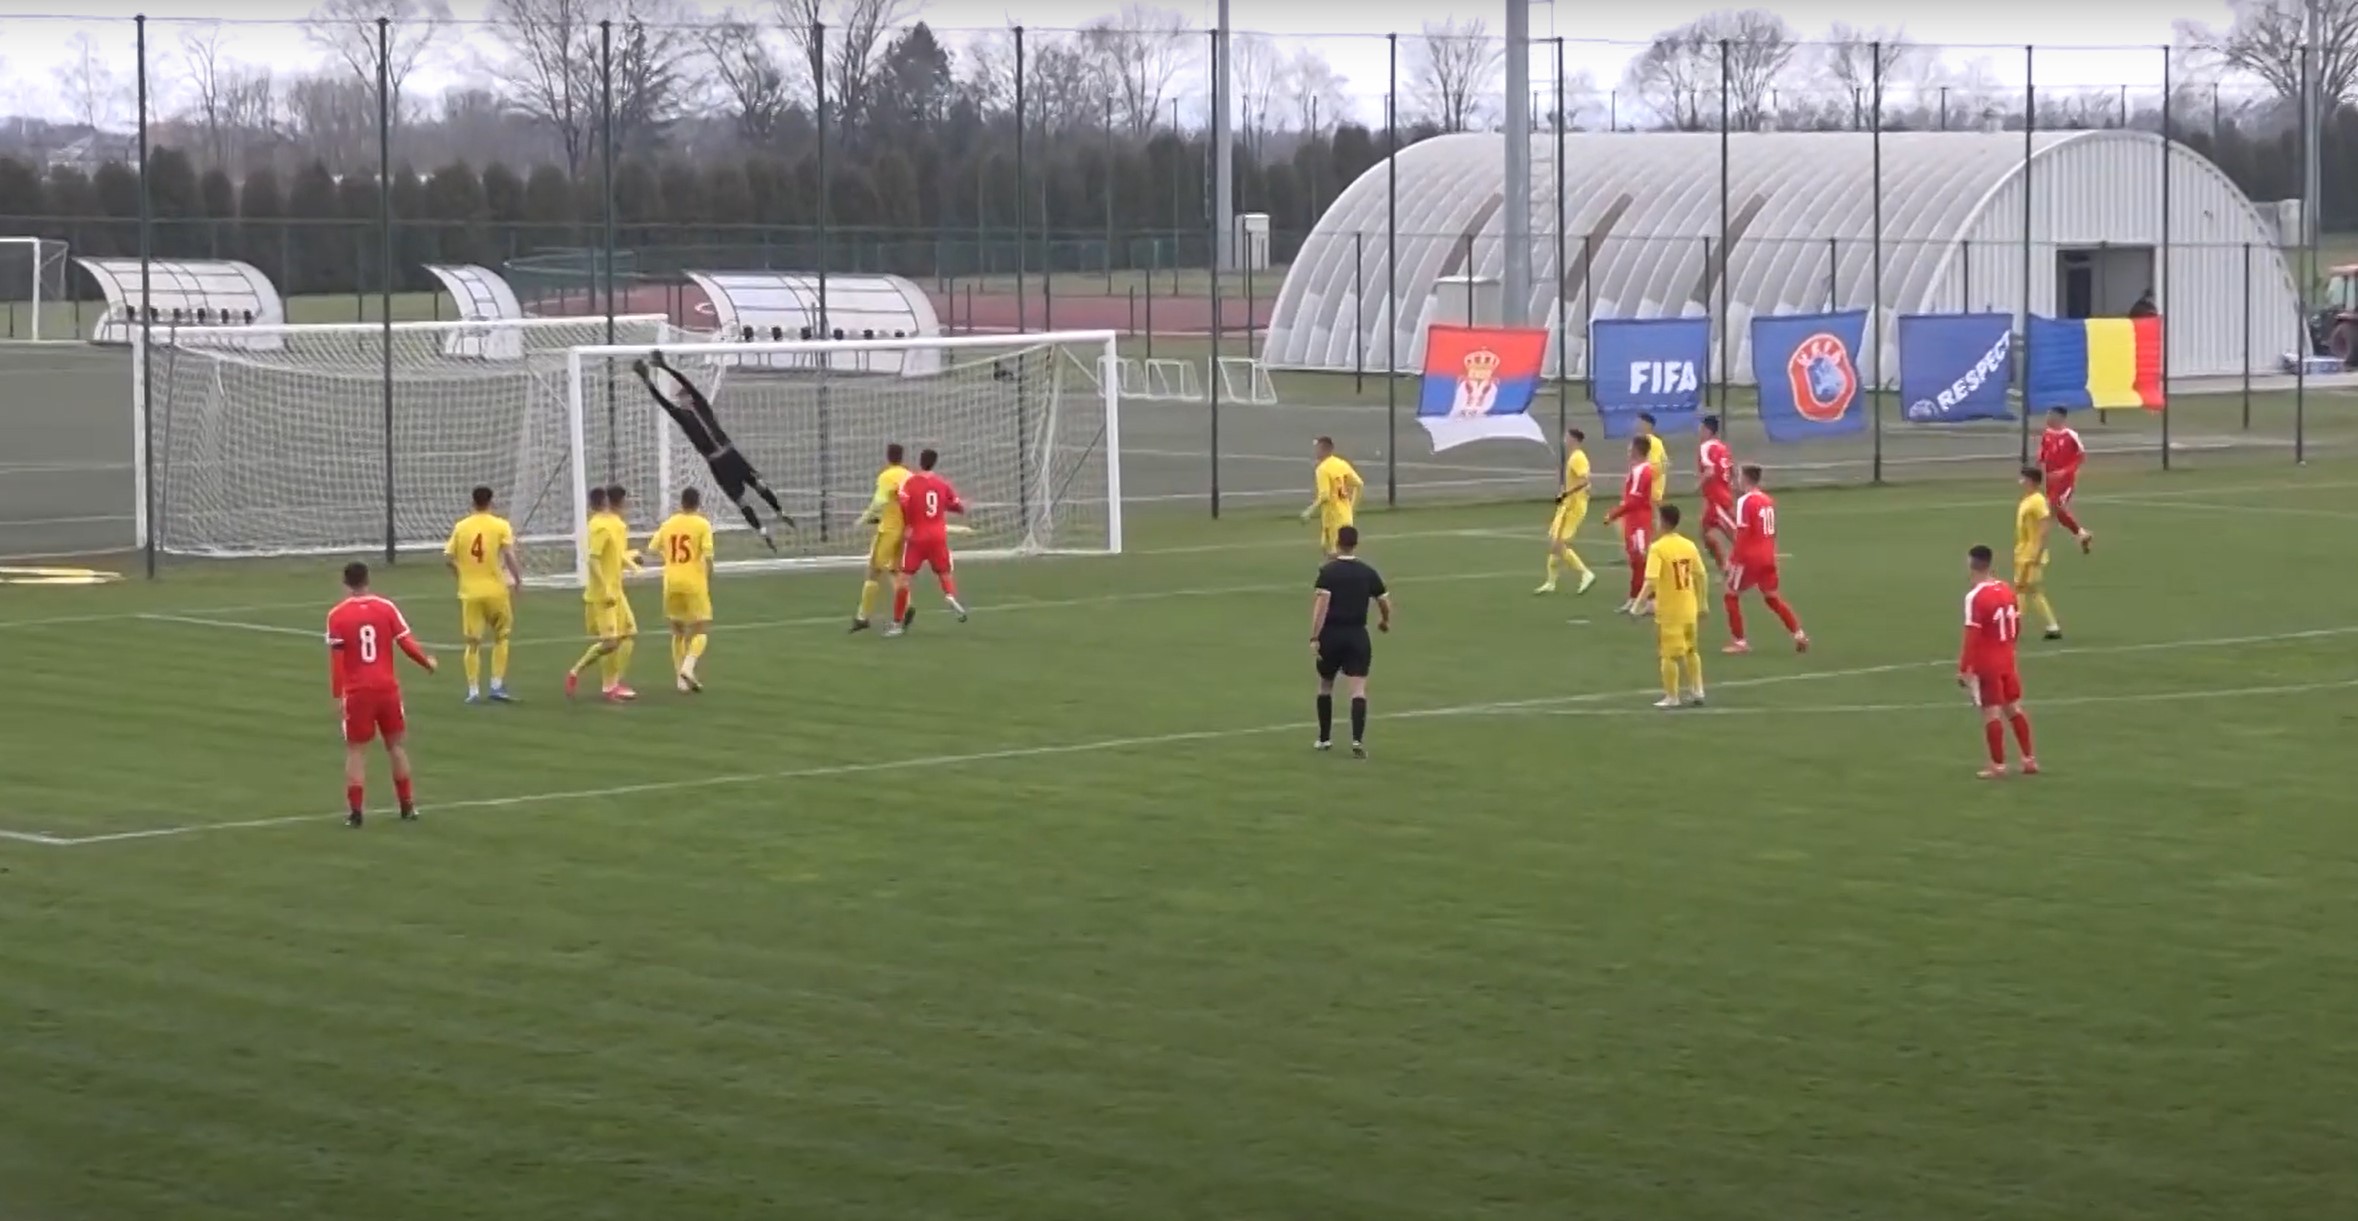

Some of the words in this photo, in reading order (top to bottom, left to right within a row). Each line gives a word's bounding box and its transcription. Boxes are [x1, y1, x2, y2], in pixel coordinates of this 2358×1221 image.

[1629, 361, 1697, 394] FIFA
[926, 490, 938, 517] 9
[1759, 506, 1775, 535] 10
[471, 532, 483, 564] 4
[670, 534, 691, 564] 15
[1672, 558, 1690, 590] 17
[1992, 604, 2016, 641] 11
[360, 625, 376, 663] 8
